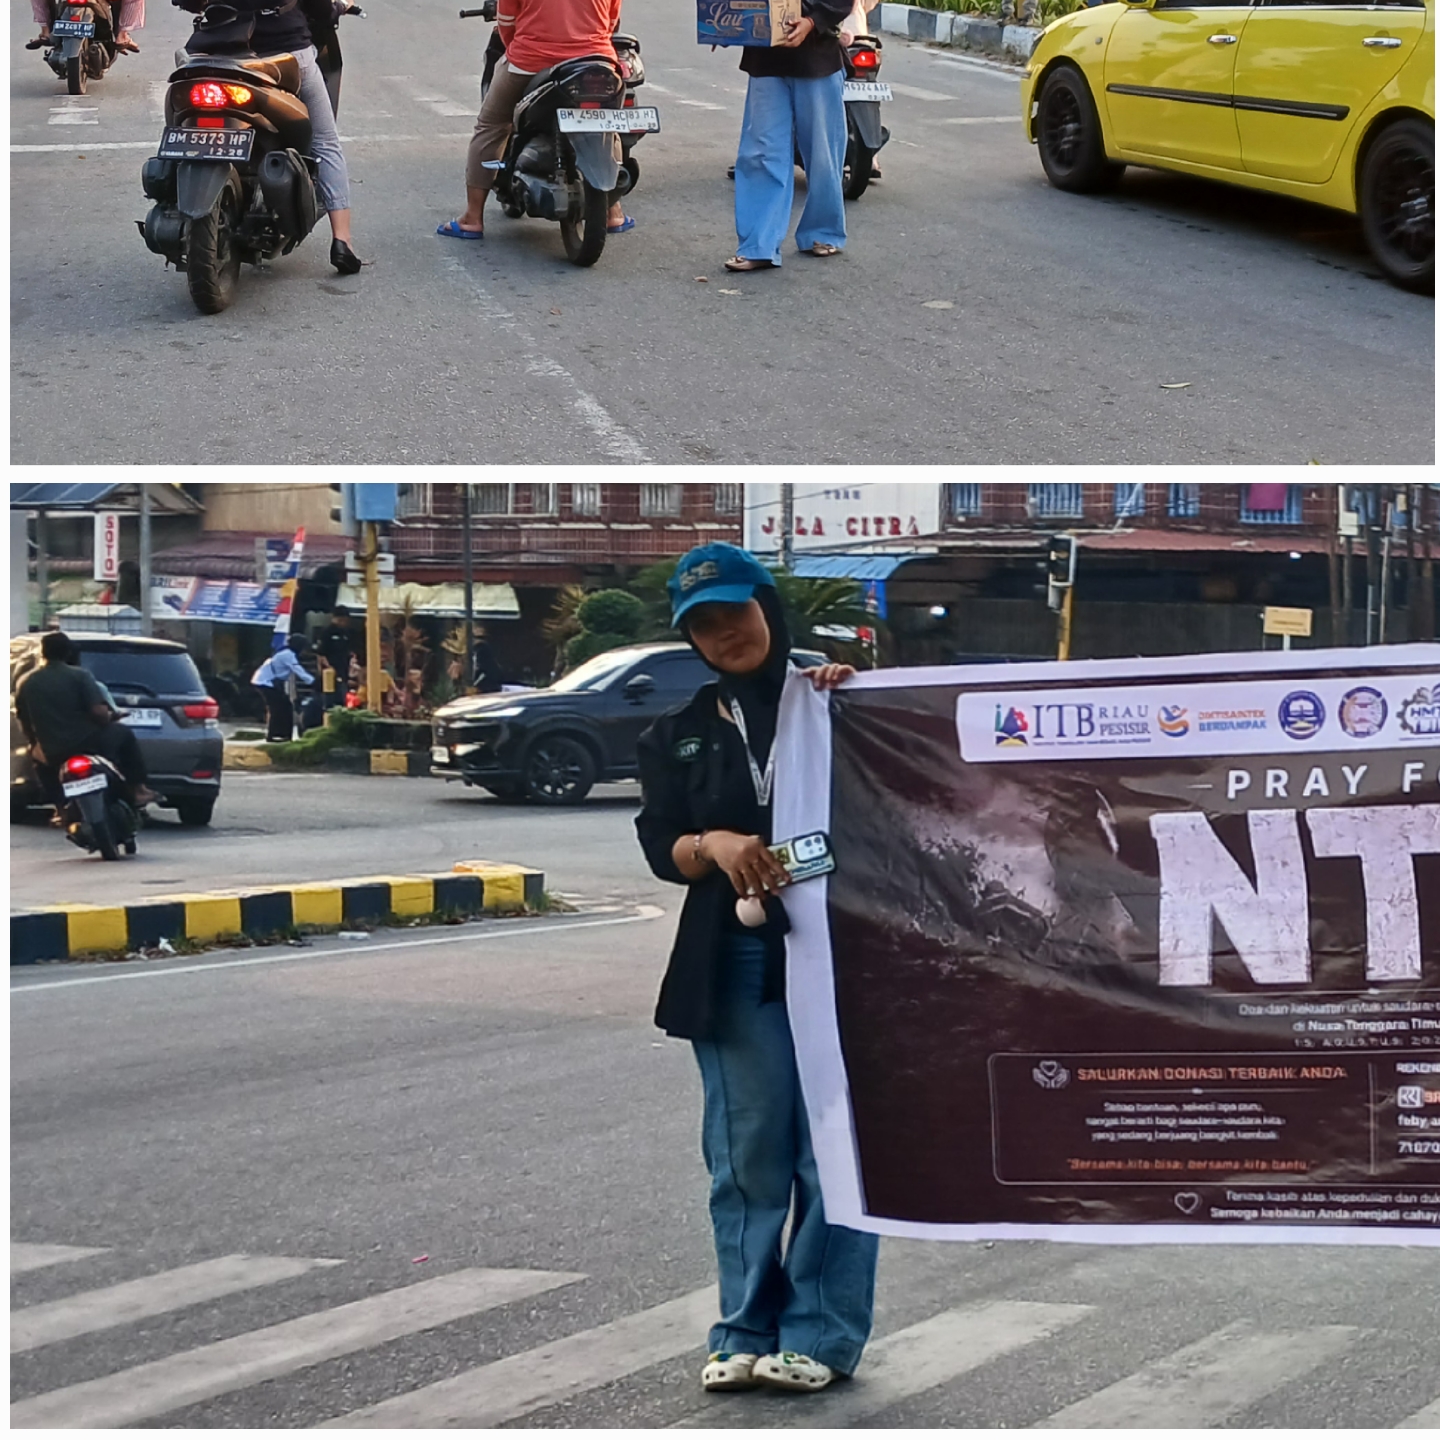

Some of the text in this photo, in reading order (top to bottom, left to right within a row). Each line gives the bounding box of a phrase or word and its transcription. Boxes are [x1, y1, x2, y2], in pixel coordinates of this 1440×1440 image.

[705, 2, 745, 32] Lau
[560, 109, 627, 121] BM 4590 HC
[168, 132, 247, 146] BM 5373 HP
[761, 515, 920, 537] JLA CITRA
[105, 515, 114, 572] SOTO
[1032, 703, 1149, 739] ITB RIAU
[1099, 722, 1152, 736] PESISIR
[1226, 764, 1369, 799] PRAY
[1078, 1066, 1348, 1081] SALURKAN DONASI TERBAIK ANDA
[1210, 1207, 1259, 1221] Semoga
